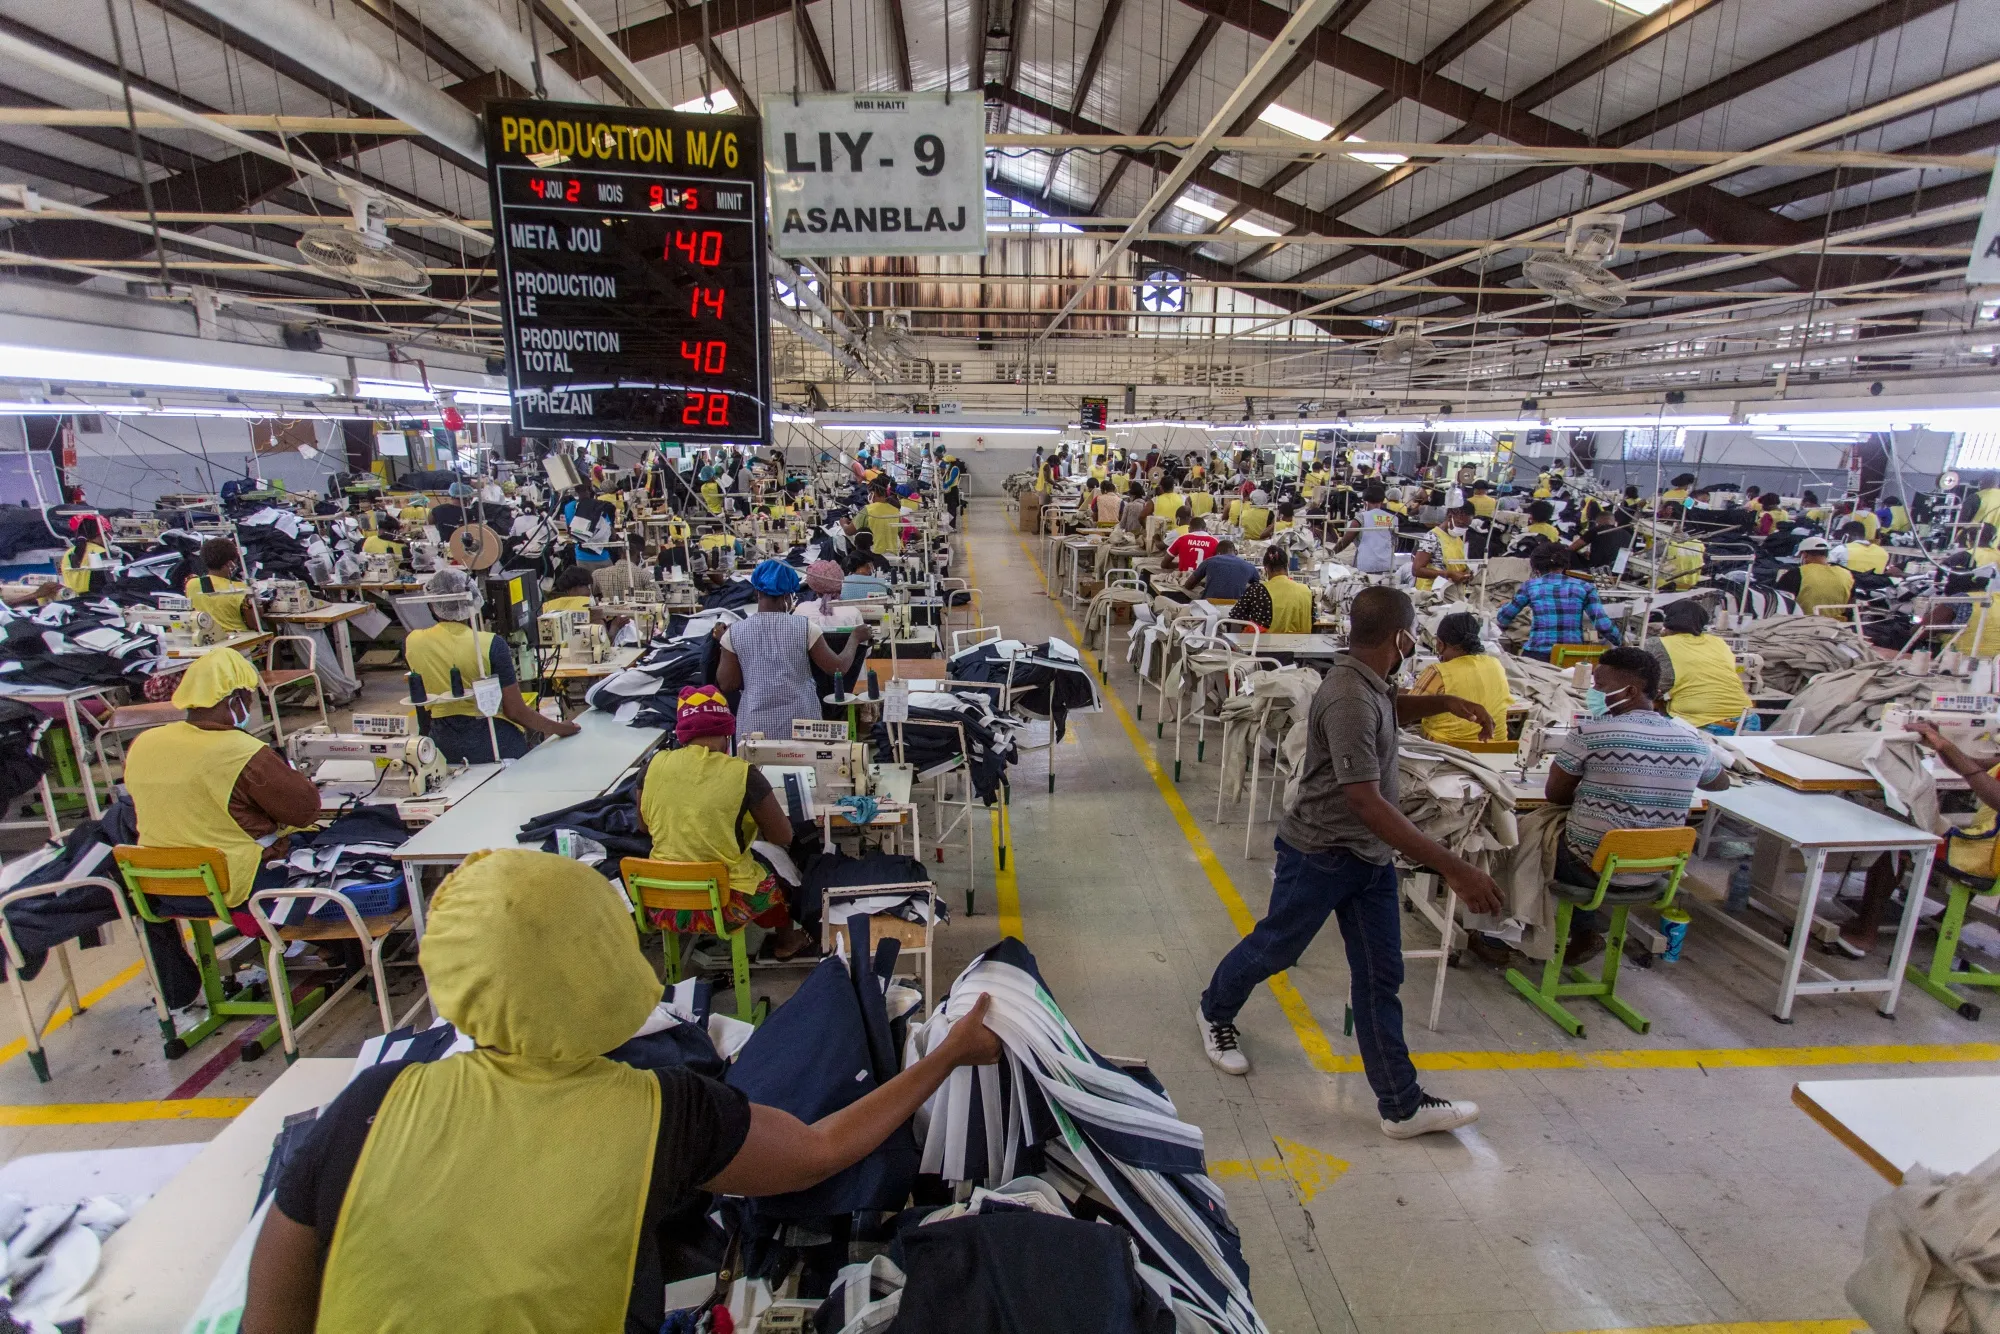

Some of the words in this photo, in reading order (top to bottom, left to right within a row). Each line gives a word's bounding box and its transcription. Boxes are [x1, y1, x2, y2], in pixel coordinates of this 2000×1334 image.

[855, 101, 875, 110] MBI
[877, 101, 905, 110] HAITI
[501, 116, 674, 164] PRODUCTION
[687, 130, 739, 169] M/6
[913, 134, 946, 177] 9
[530, 179, 545, 199] 4
[545, 183, 563, 199] JOU
[565, 180, 581, 203] 2
[598, 183, 623, 203] MOIS
[716, 191, 743, 211] MINIT
[782, 206, 966, 233] ASANBLAJ
[511, 224, 559, 250] META
[567, 227, 601, 253] JOU
[664, 229, 723, 267] 140
[515, 271, 617, 299] PRODUCTION
[517, 295, 538, 317] LE
[691, 286, 725, 320] 14
[520, 327, 620, 353] PRODUCTION
[522, 351, 574, 373] TOTAL
[681, 340, 727, 374] 40
[527, 390, 594, 415] PREZAN
[1187, 539, 1210, 548] NAZON
[682, 706, 700, 717] EX
